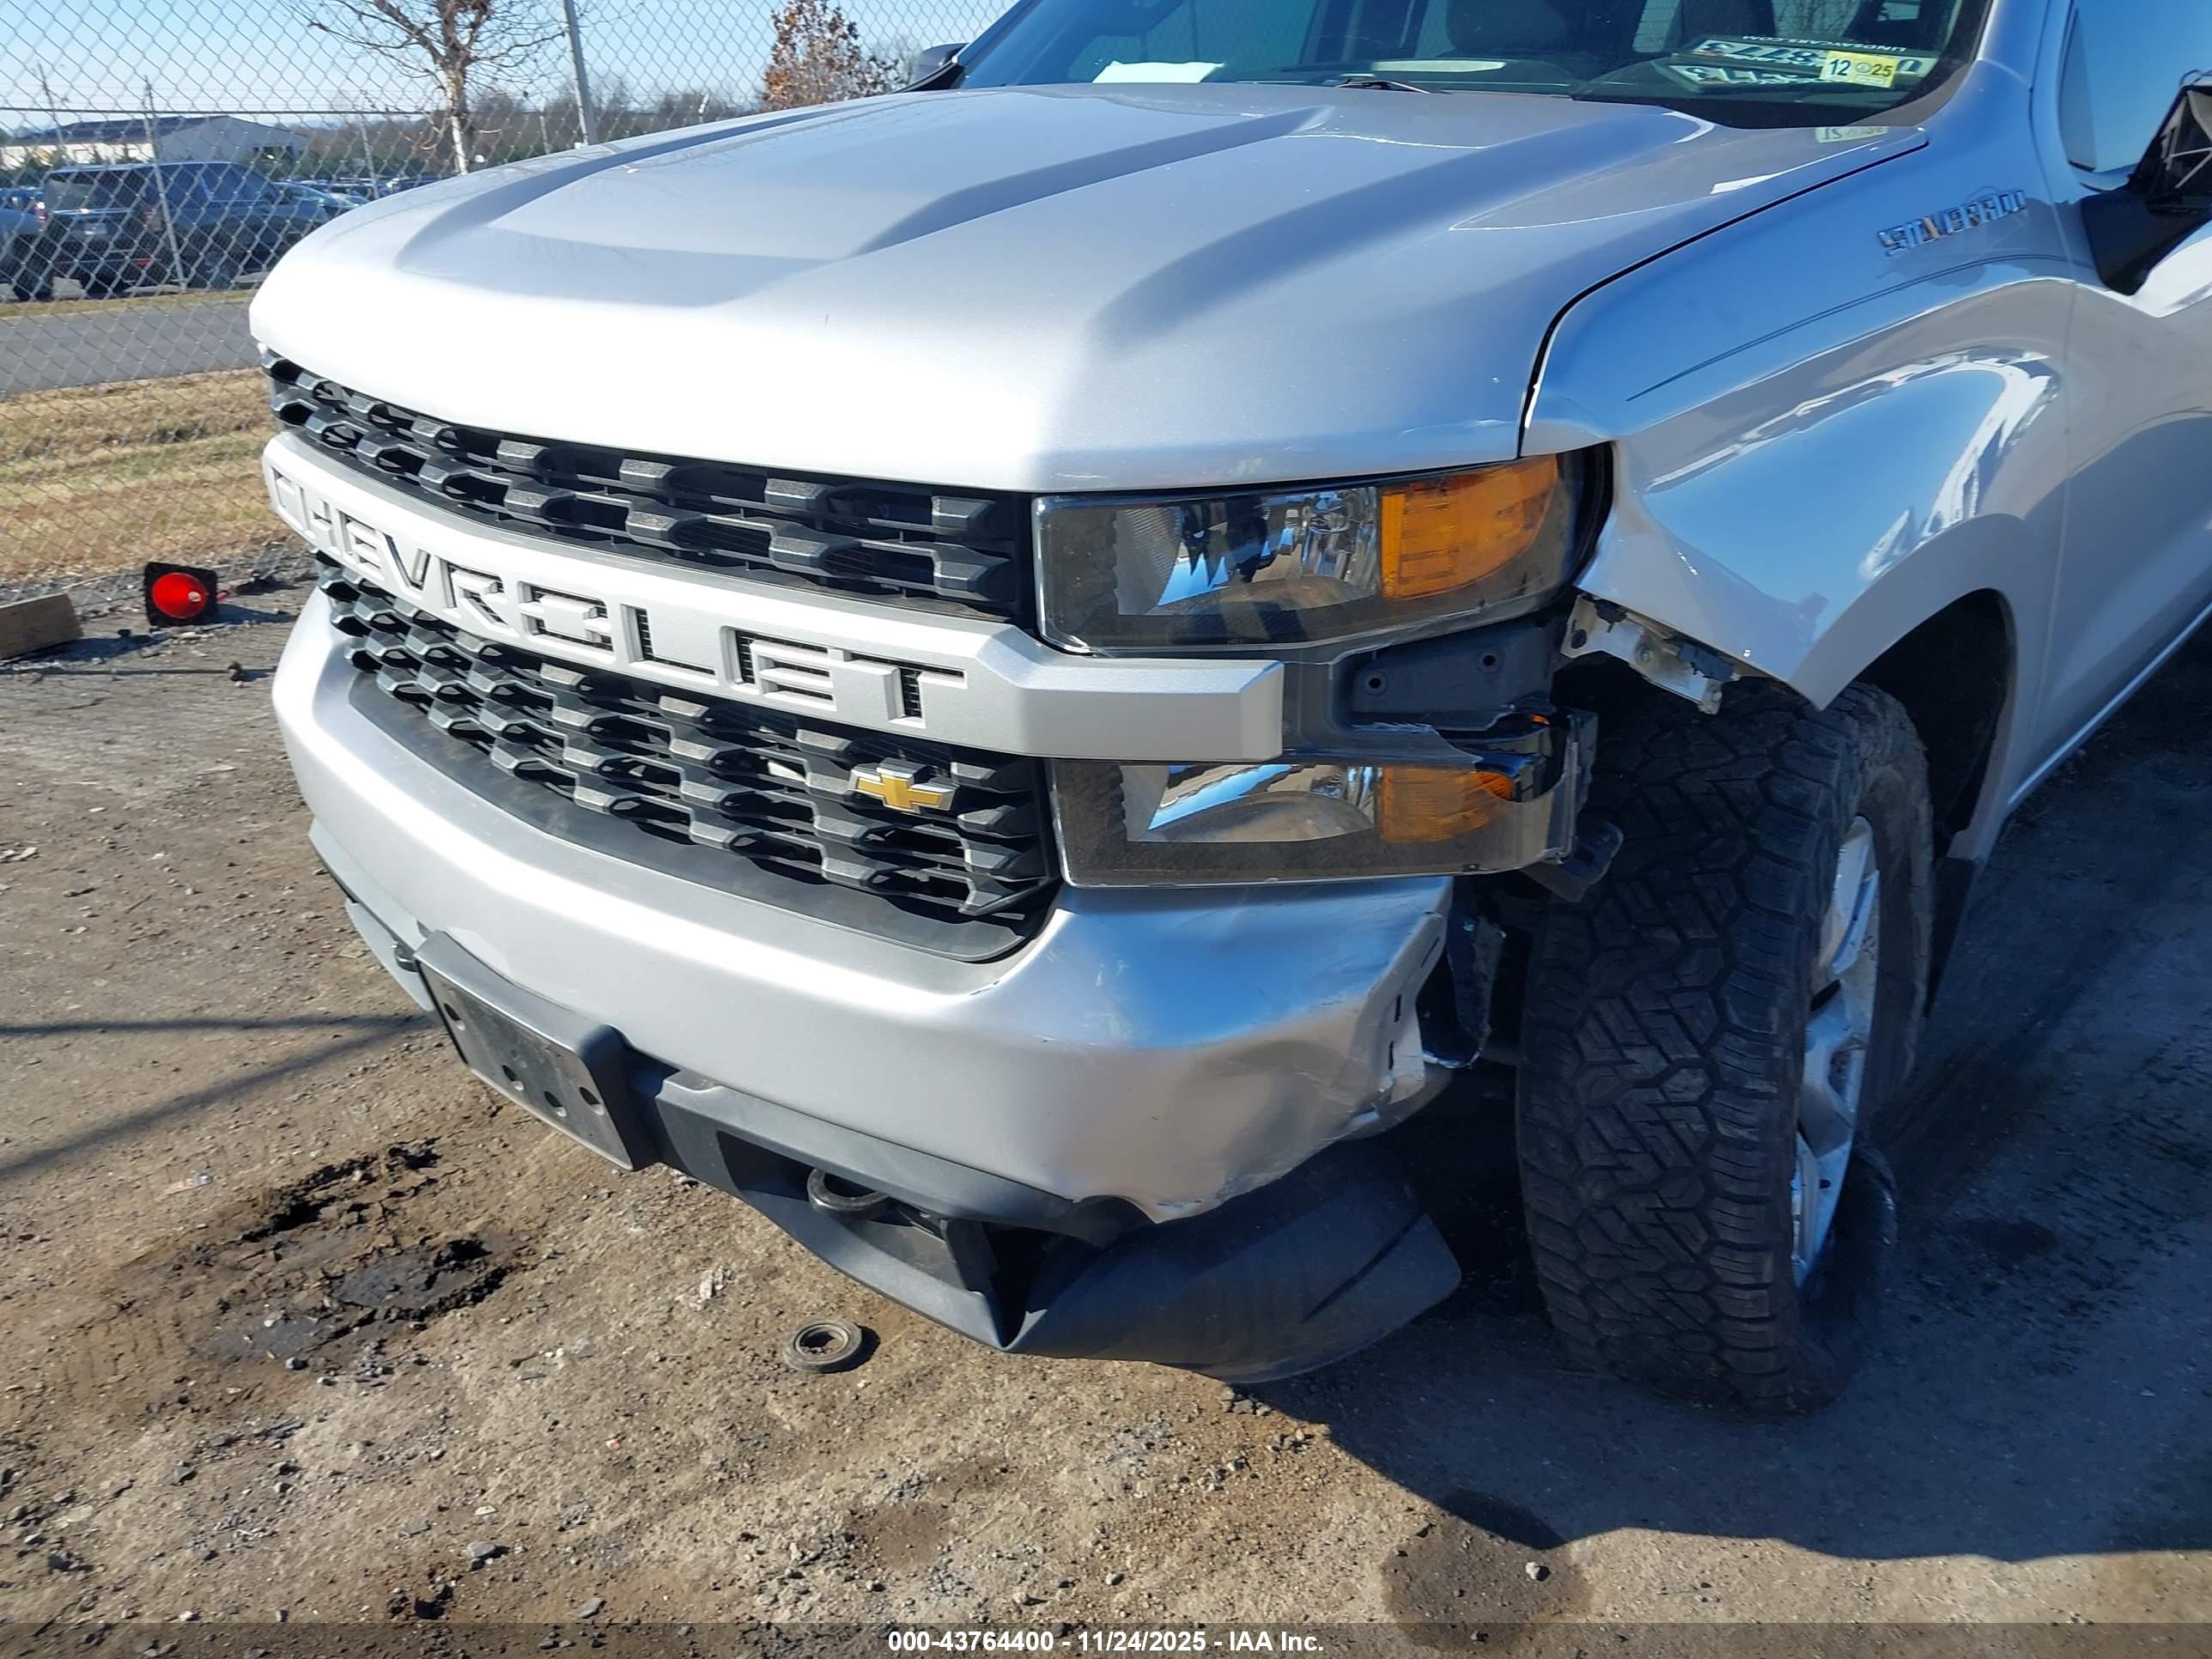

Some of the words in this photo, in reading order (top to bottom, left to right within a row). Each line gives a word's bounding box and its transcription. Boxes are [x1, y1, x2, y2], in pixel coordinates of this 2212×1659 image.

[1742, 34, 1907, 53] LINDSAYCARS.COM
[1829, 58, 1851, 76] 12
[1871, 63, 1893, 77] 25
[270, 466, 967, 729] CHEVROLET
